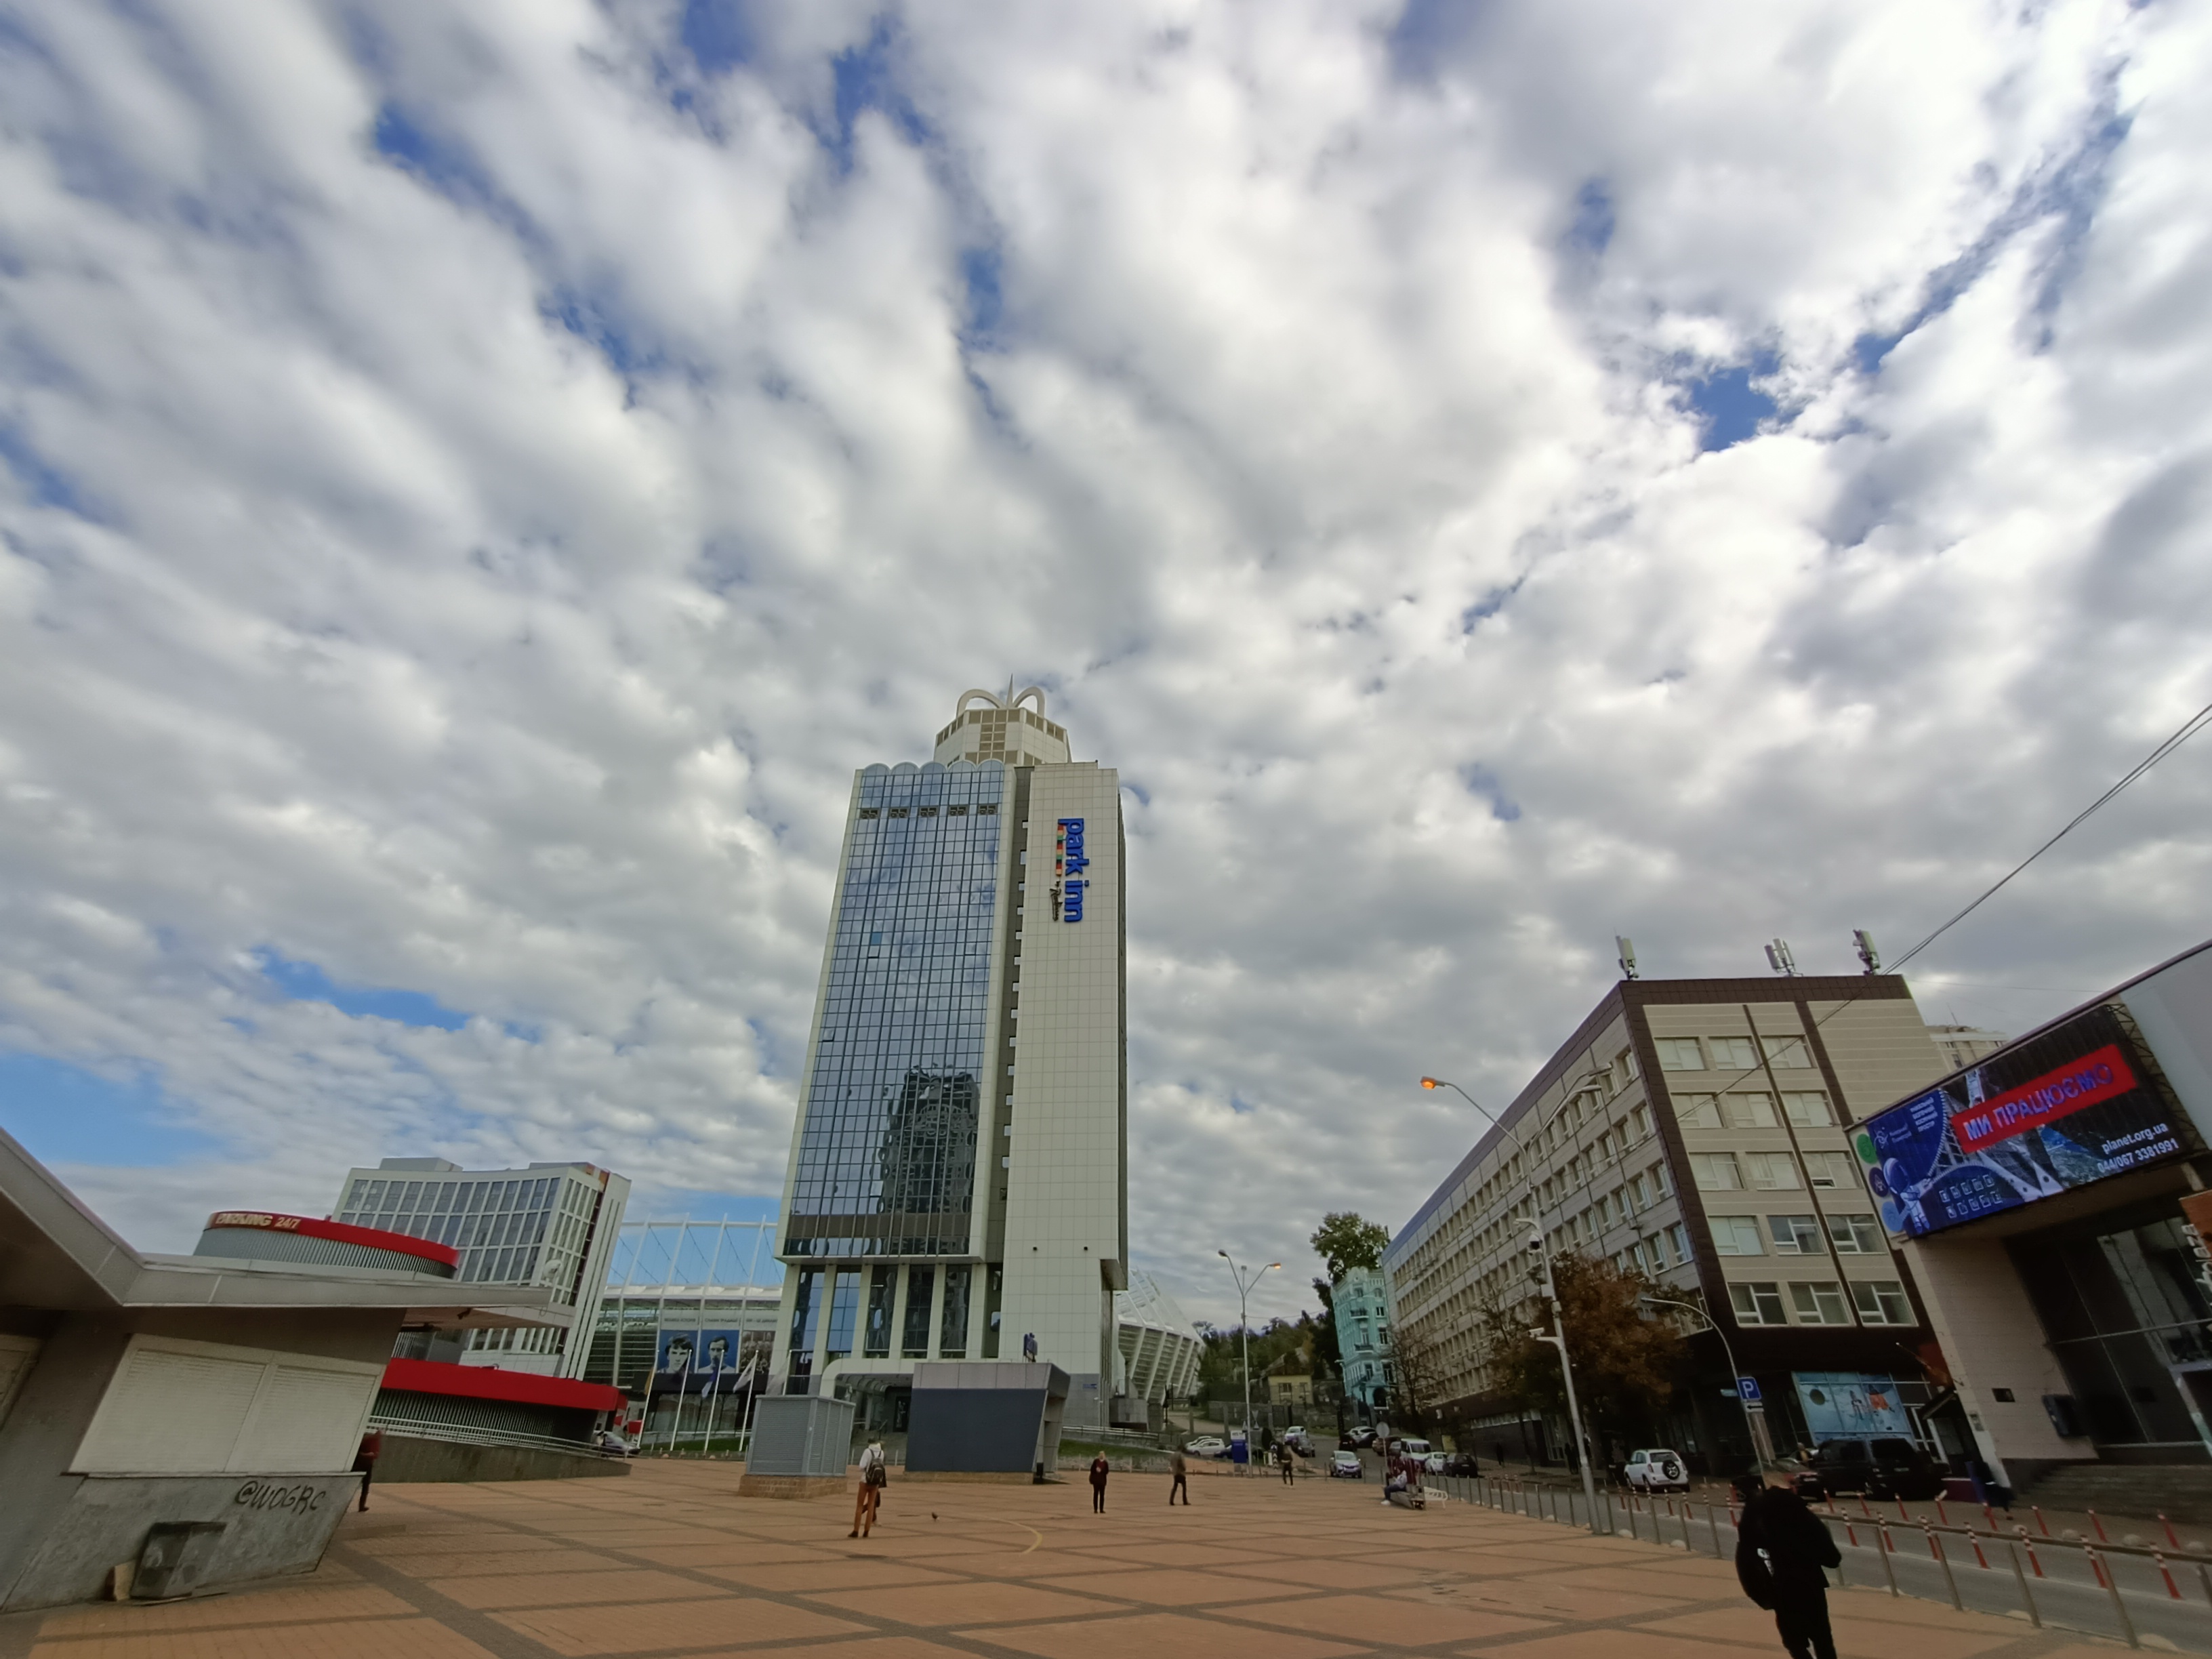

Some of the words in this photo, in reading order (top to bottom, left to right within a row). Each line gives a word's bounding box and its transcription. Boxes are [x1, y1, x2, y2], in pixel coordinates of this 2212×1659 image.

[1057, 818, 1089, 876] park
[1064, 880, 1089, 923] inn
[1963, 1114, 1994, 1141] МИ
[1993, 1063, 2113, 1128] ПРАЦЮЄМО
[2097, 1152, 2134, 1173] 044/067
[2135, 1138, 2179, 1161] 3381991
[2102, 1123, 2169, 1155] planet.org.ua
